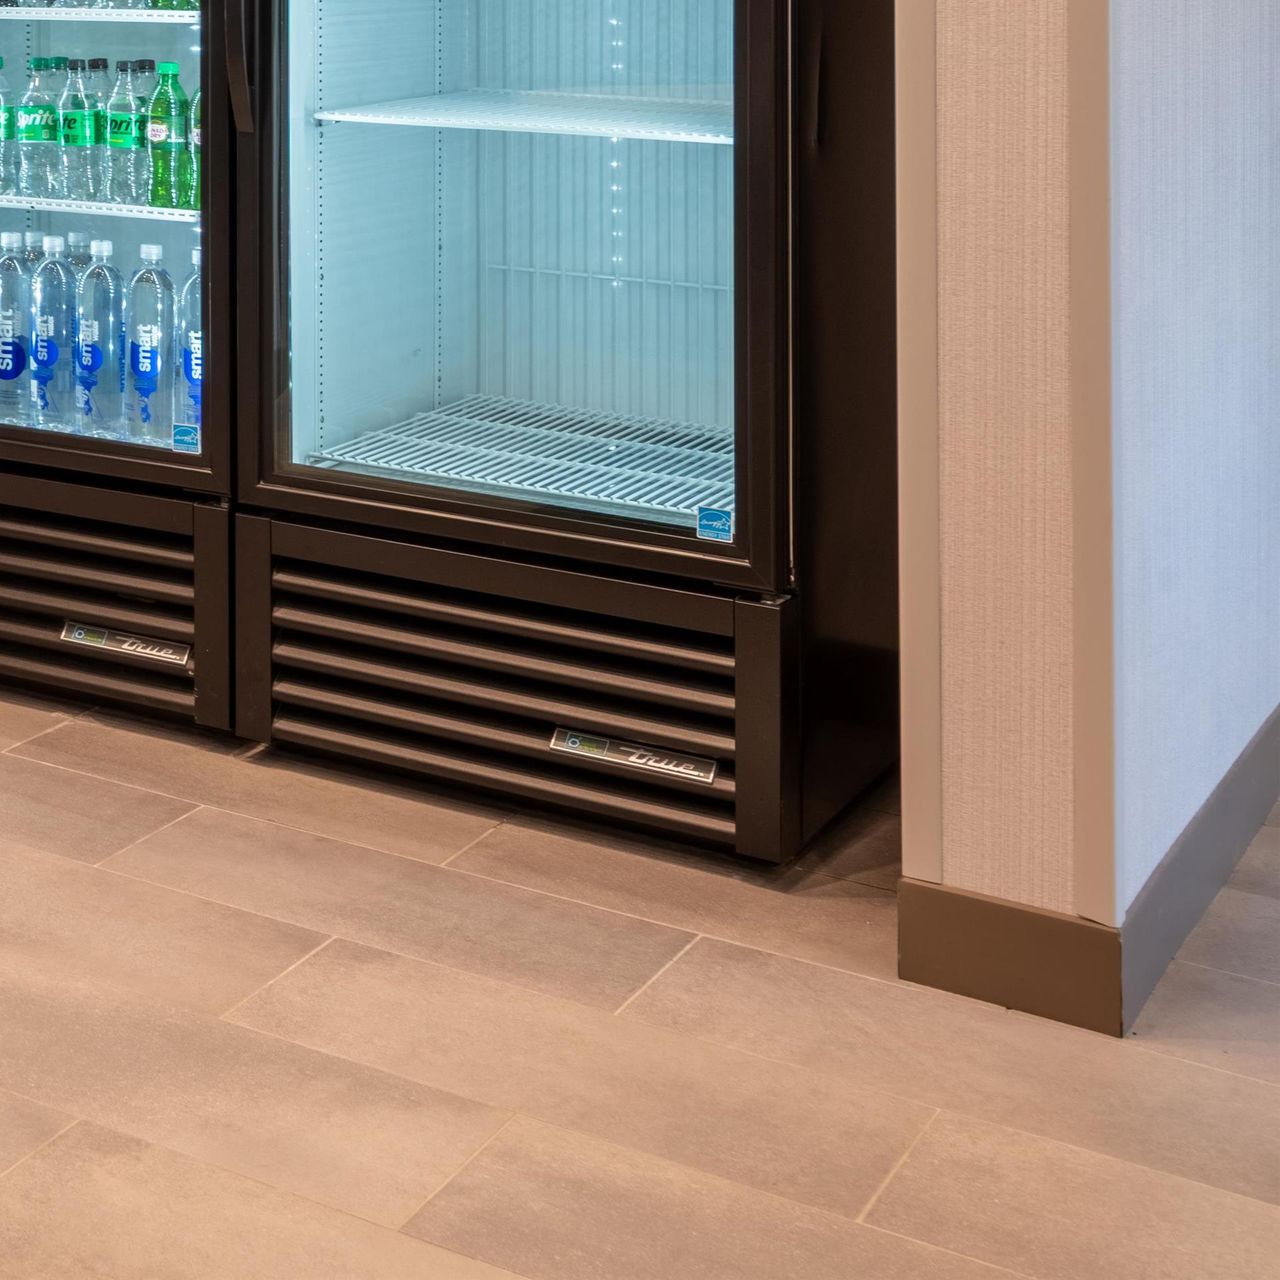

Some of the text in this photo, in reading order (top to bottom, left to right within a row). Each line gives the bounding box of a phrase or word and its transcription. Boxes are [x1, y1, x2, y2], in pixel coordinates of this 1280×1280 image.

[16, 109, 55, 128] Sprite
[37, 315, 48, 361] smart
[81, 319, 92, 366] smart
[138, 324, 152, 372] smart
[189, 330, 202, 379] smart
